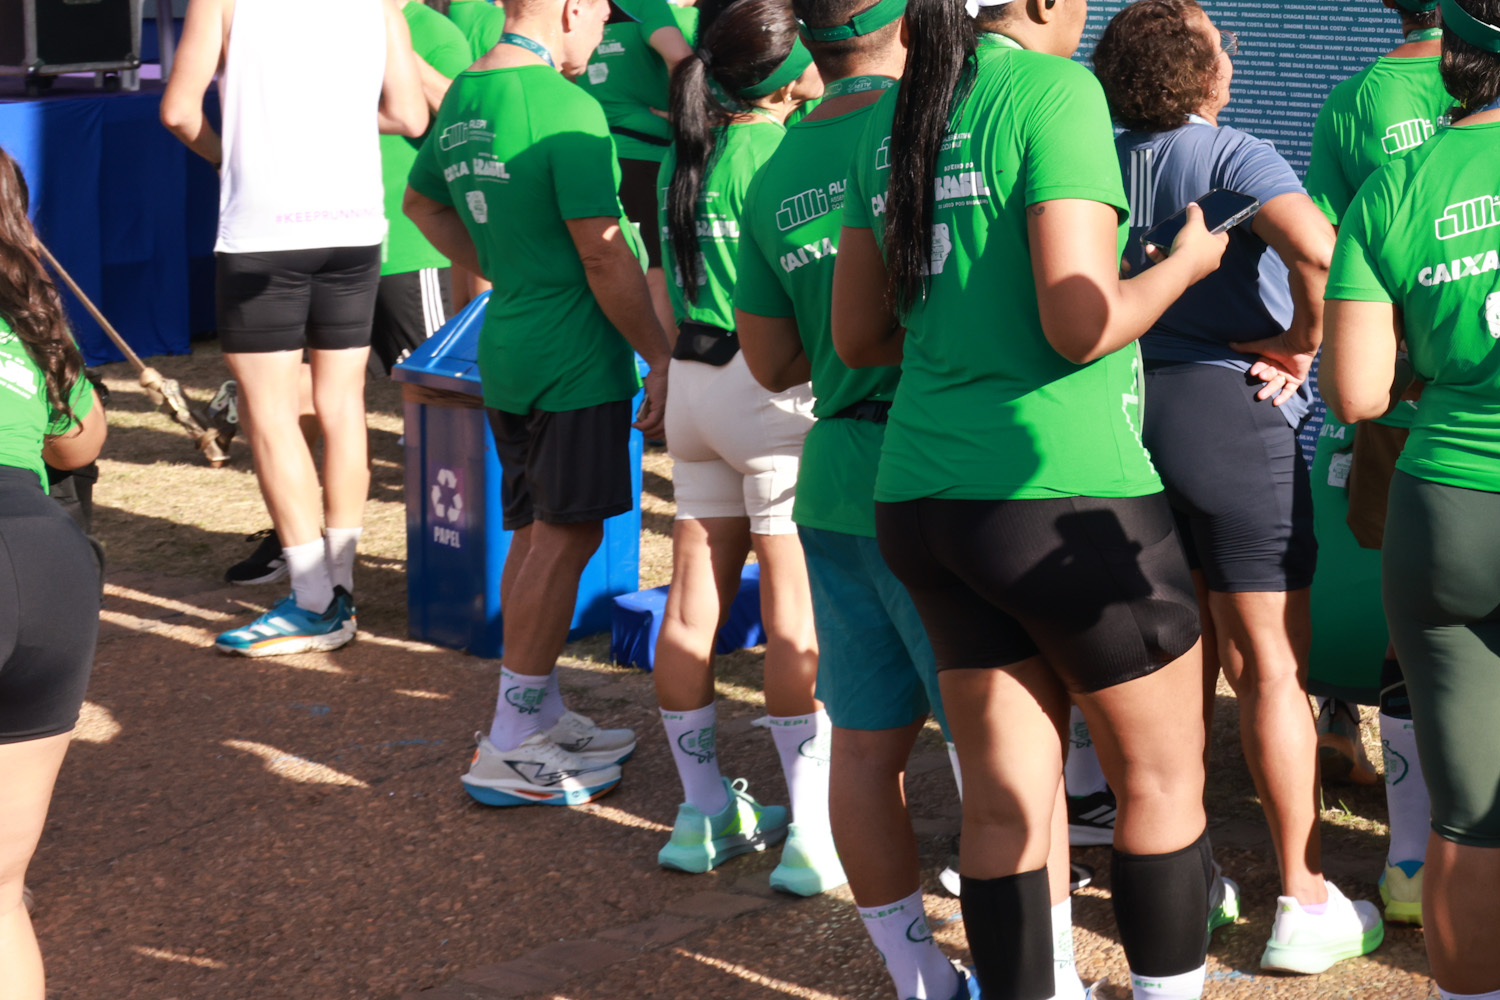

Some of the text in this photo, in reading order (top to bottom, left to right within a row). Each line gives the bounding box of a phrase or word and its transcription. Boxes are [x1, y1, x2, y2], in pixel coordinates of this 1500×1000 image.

[934, 170, 991, 202] BRASIL
[1418, 249, 1500, 287] CAIXA
[434, 526, 461, 548] PAPEL
